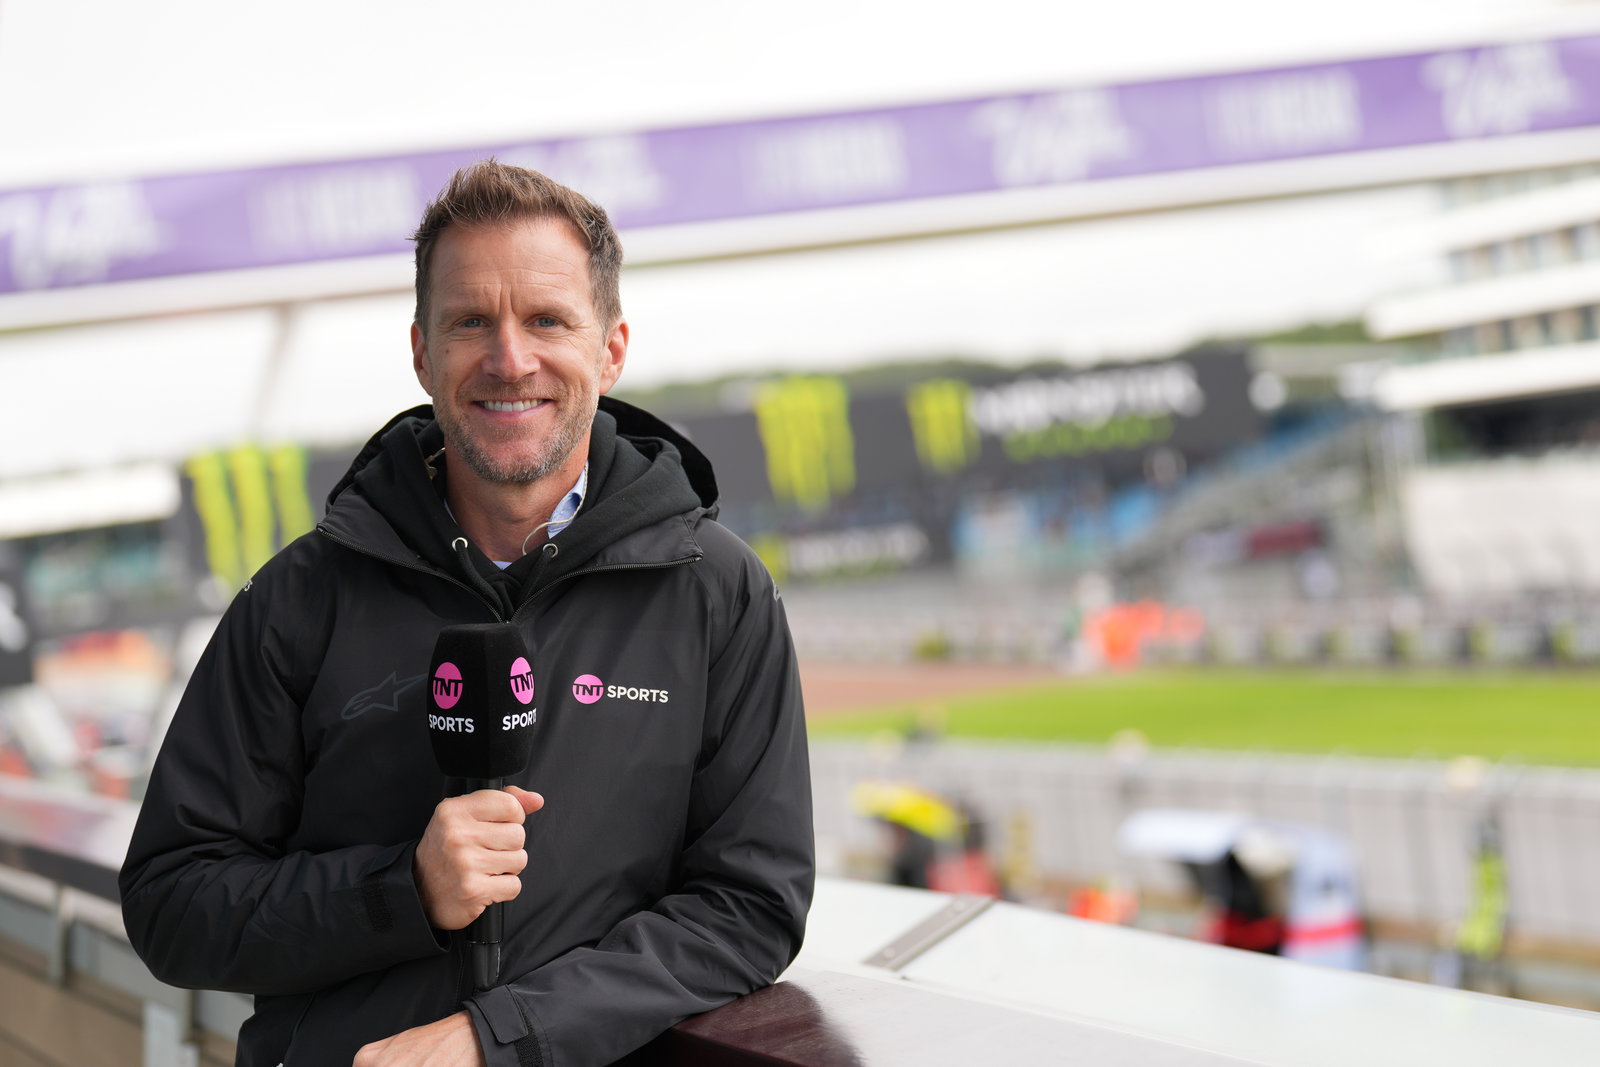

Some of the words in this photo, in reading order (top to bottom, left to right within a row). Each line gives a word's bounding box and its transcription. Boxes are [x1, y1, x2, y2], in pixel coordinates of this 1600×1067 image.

[433, 676, 463, 697] TNT
[509, 671, 534, 693] TNT
[573, 683, 604, 697] TNT
[607, 685, 669, 703] SPORTS
[428, 713, 475, 733] SPORTS
[502, 707, 537, 731] SPORT
